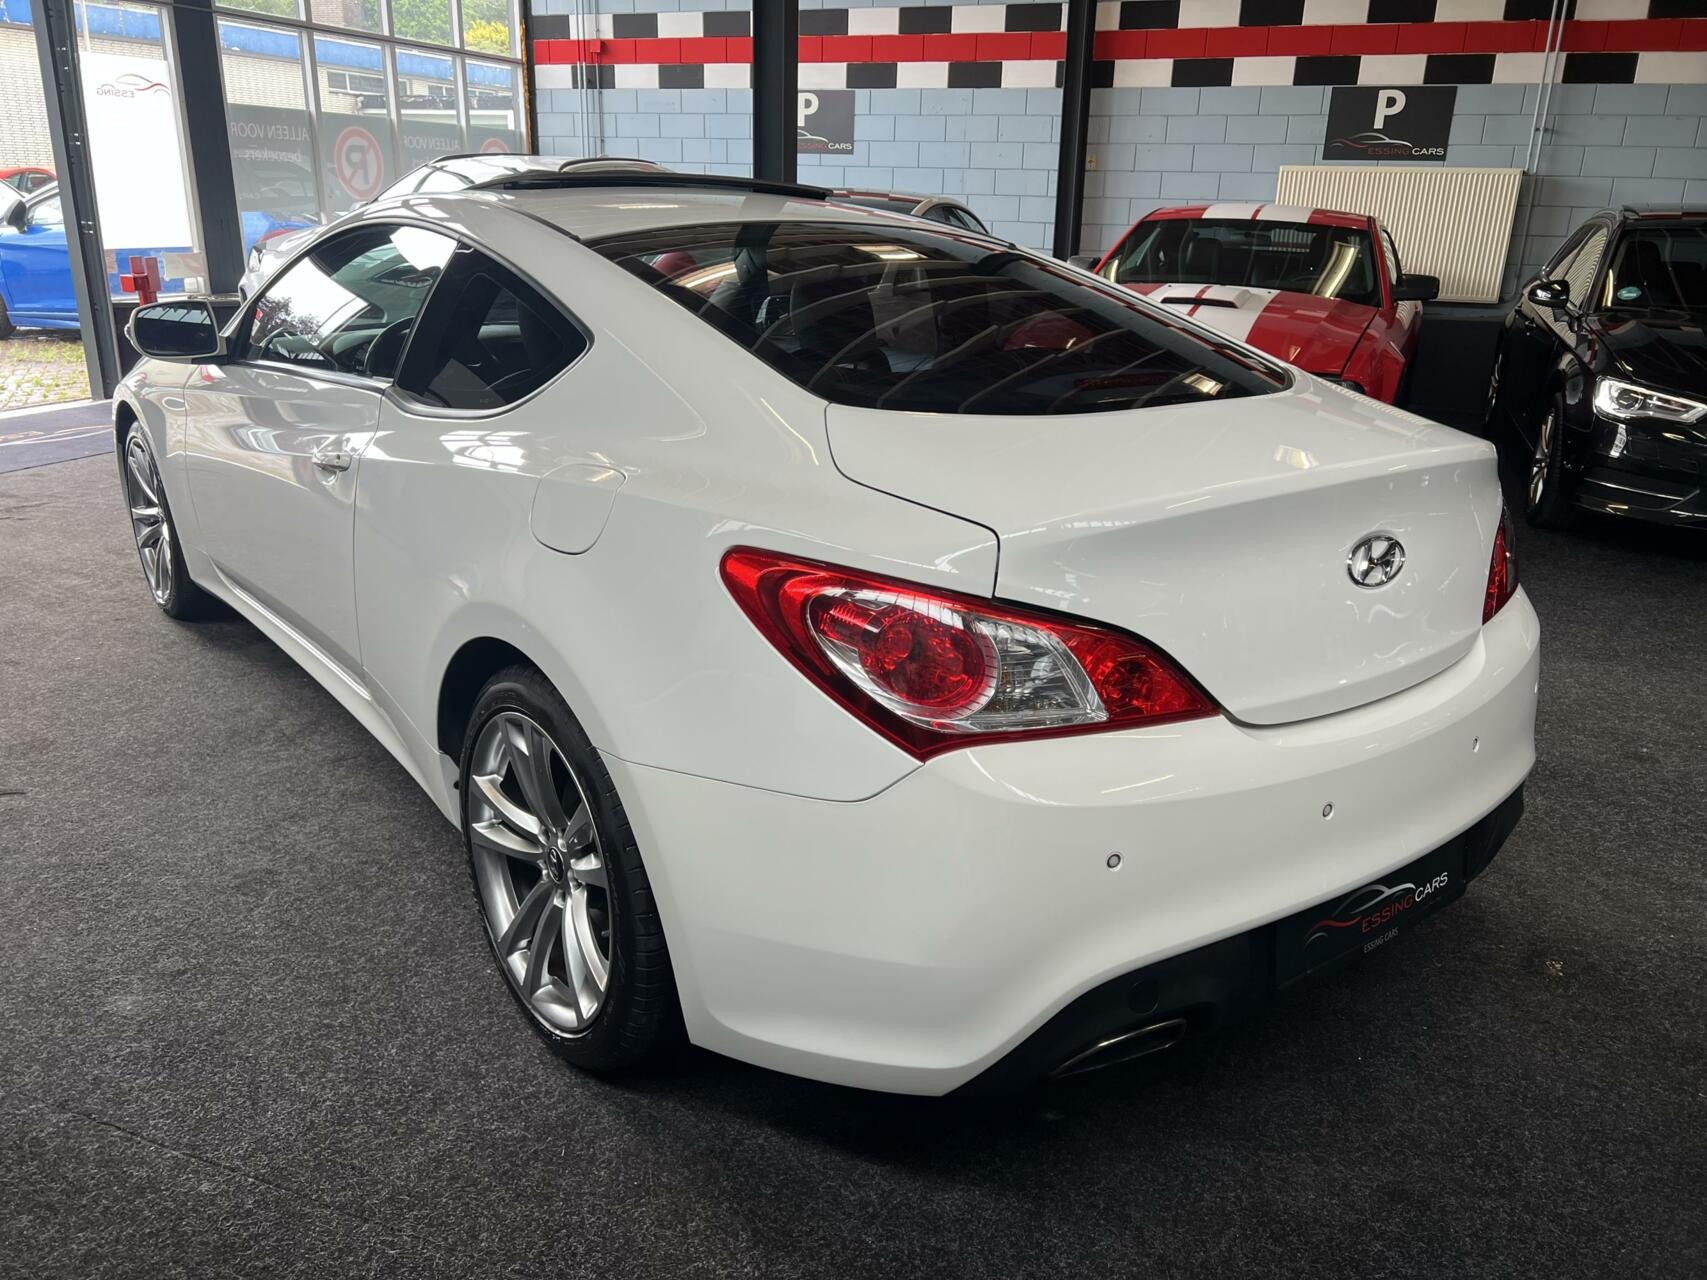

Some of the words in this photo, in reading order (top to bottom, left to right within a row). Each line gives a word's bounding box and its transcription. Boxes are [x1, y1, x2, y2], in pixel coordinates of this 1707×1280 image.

[798, 92, 819, 127] P
[1373, 89, 1406, 129] P
[828, 142, 852, 150] CARS
[1368, 147, 1408, 156] ESSING
[1411, 147, 1444, 156] CARS
[1362, 894, 1413, 933] ESSING
[1415, 872, 1448, 902] CARS
